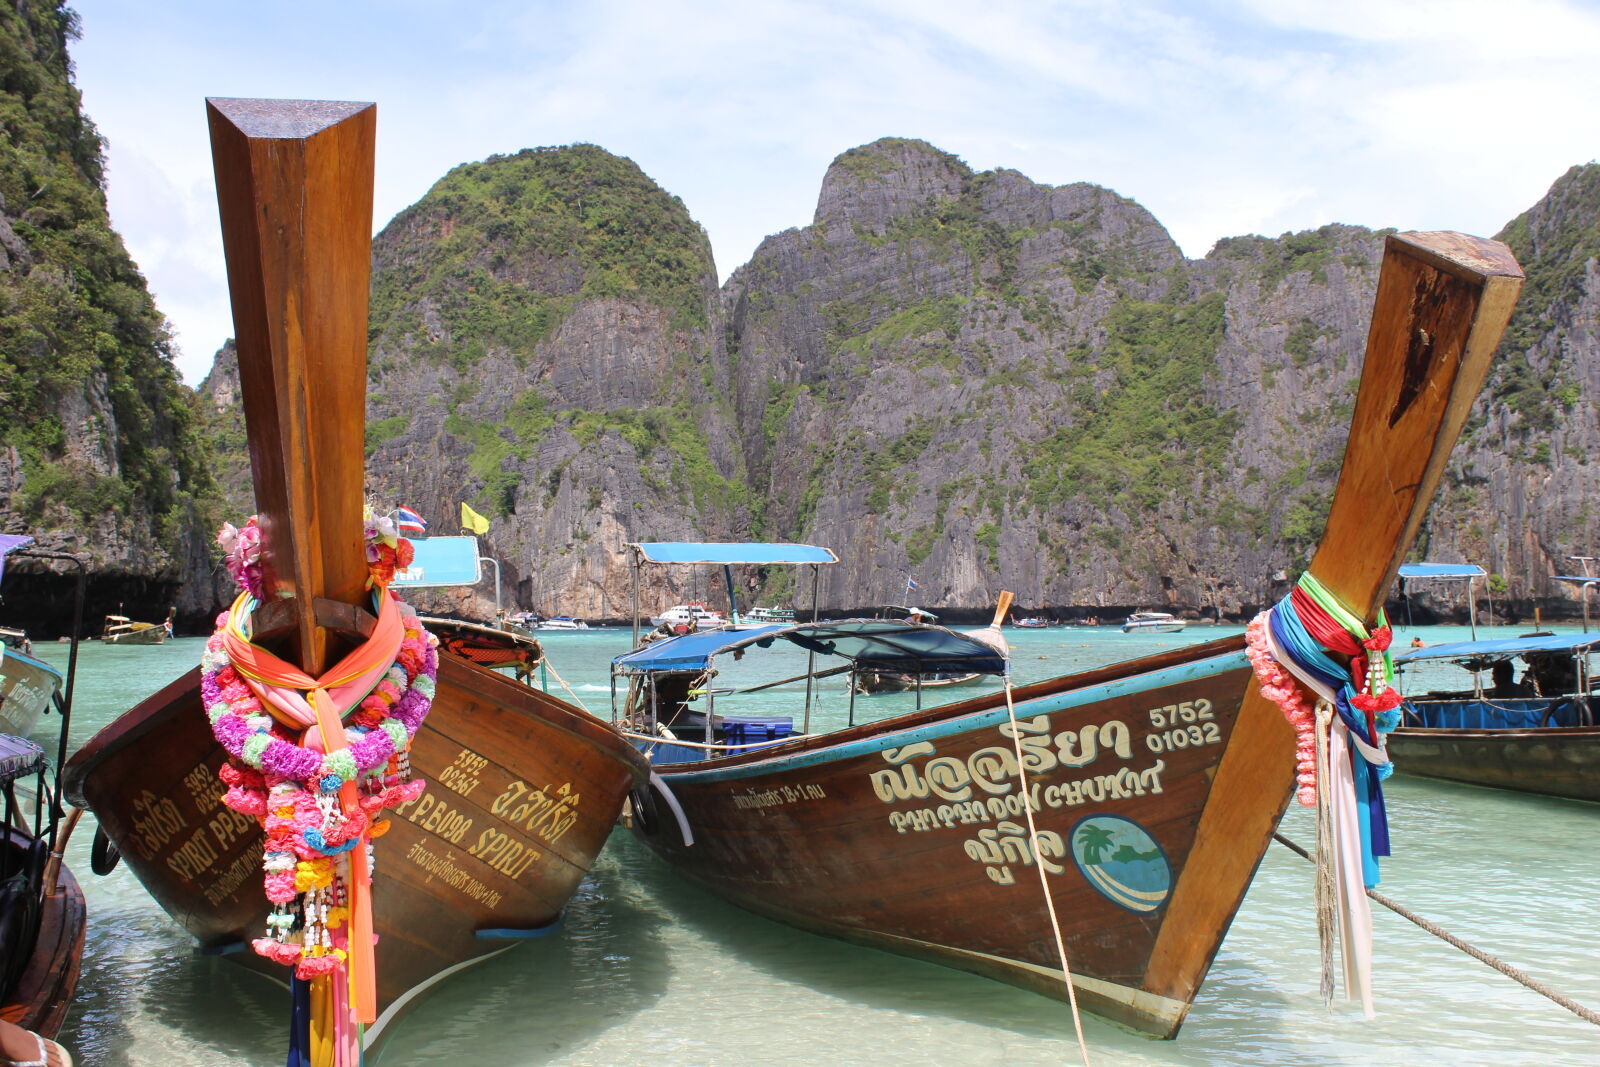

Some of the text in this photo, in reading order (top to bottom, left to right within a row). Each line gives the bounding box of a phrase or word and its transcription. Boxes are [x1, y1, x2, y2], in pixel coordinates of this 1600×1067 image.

[1149, 699, 1215, 728] 5752
[1146, 722, 1221, 753] 01032
[453, 749, 489, 775] 5952
[889, 808, 941, 834] PHI
[937, 800, 991, 828] PHI
[987, 783, 1041, 820] DON
[166, 827, 218, 880] SPIRIT
[468, 828, 541, 880] SPIRIT
